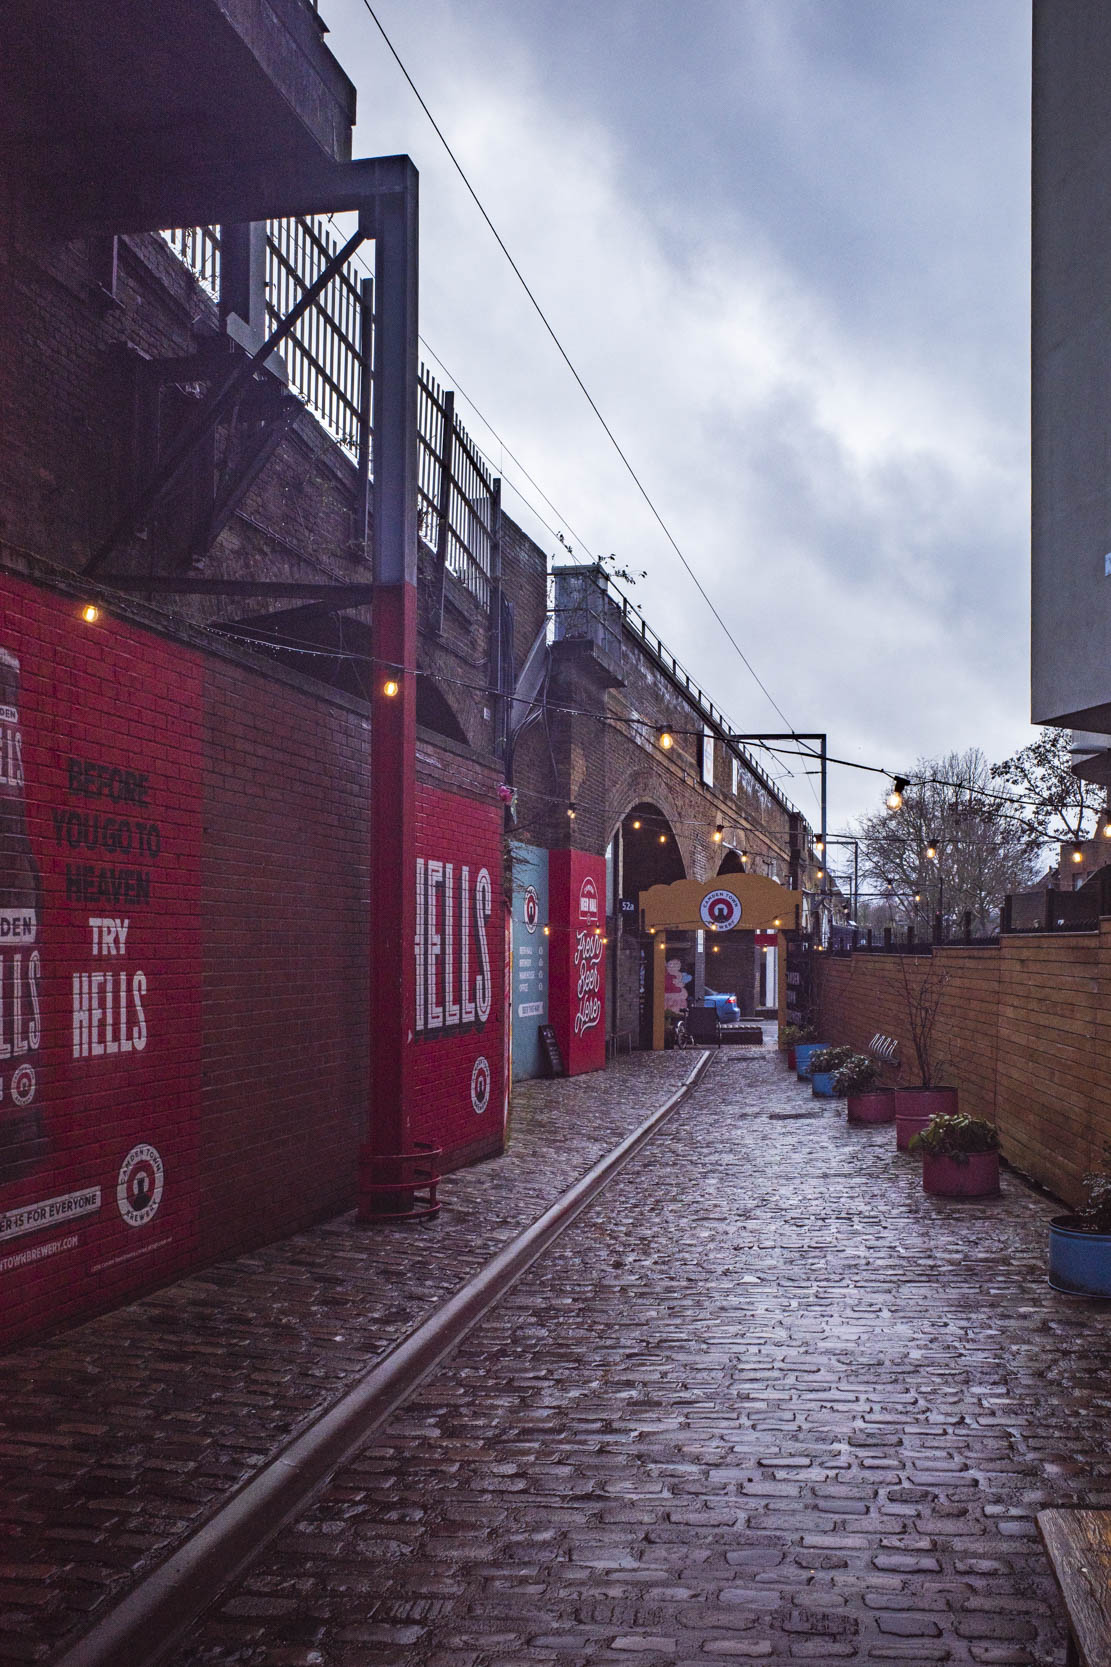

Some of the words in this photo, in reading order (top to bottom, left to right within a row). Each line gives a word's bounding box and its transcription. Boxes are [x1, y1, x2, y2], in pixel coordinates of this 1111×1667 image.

[68, 757, 149, 809] BEFORE
[53, 807, 99, 851] YOU
[103, 816, 131, 855] GO
[136, 822, 161, 860] TO
[65, 863, 150, 906] HEAVEN
[622, 901, 635, 911] 52a
[89, 918, 129, 956] TRY
[574, 929, 603, 966] Fresh
[577, 959, 600, 998] Beer
[72, 969, 148, 1059] HELLS
[574, 994, 601, 1038] Here
[120, 1148, 145, 1185] CAMDEN
[146, 1148, 162, 1174] TOWN
[27, 1208, 47, 1224] FOR
[49, 1193, 97, 1218] EVERYONE
[126, 1197, 158, 1222] BREWERY
